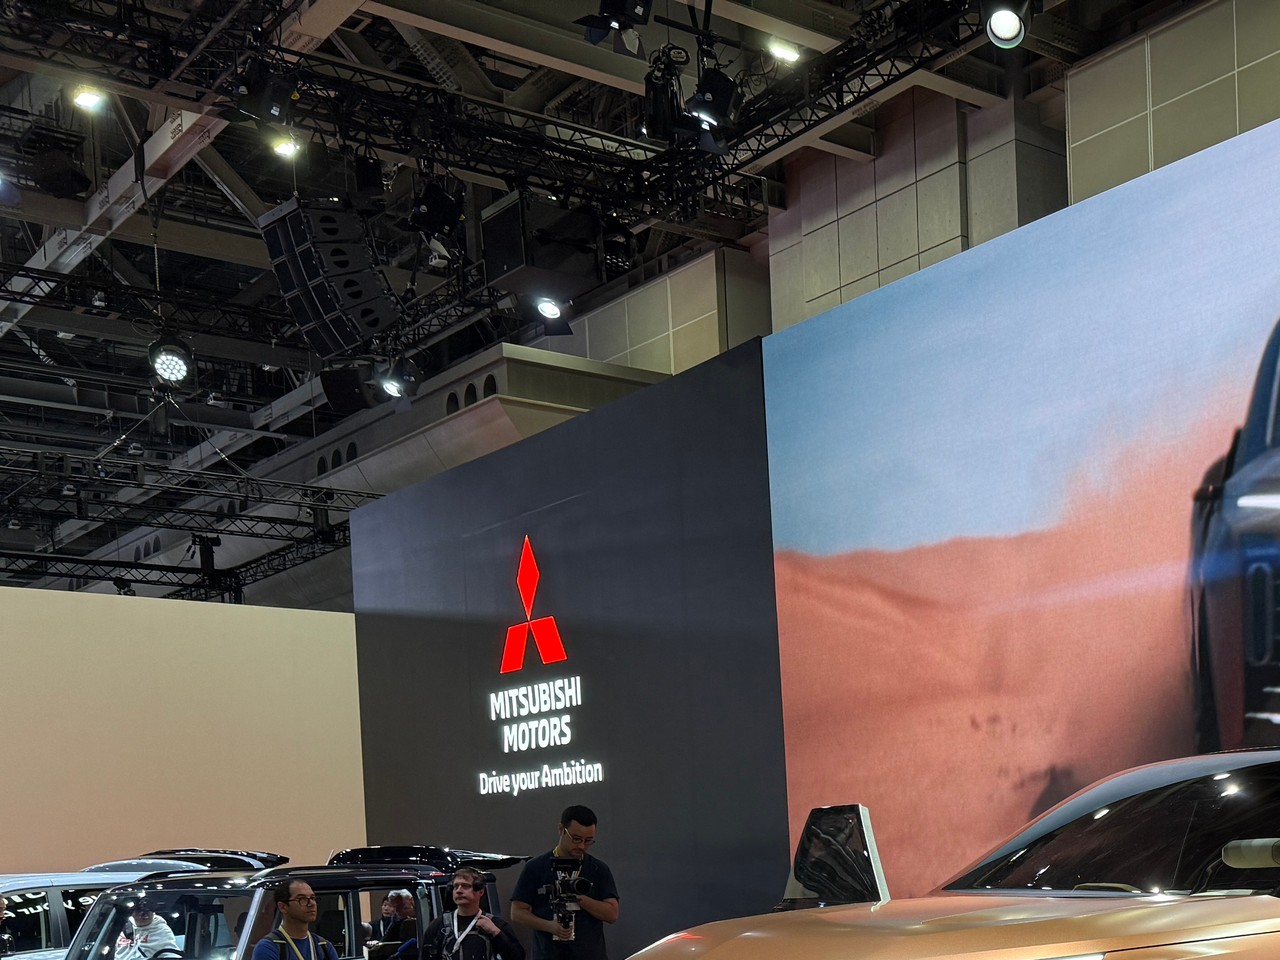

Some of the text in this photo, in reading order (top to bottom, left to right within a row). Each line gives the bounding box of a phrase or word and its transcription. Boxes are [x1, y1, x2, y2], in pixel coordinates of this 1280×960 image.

[490, 676, 582, 721] MITSUBISHI
[503, 714, 572, 753] MOTORS
[479, 758, 603, 797] Drive your Ambition
